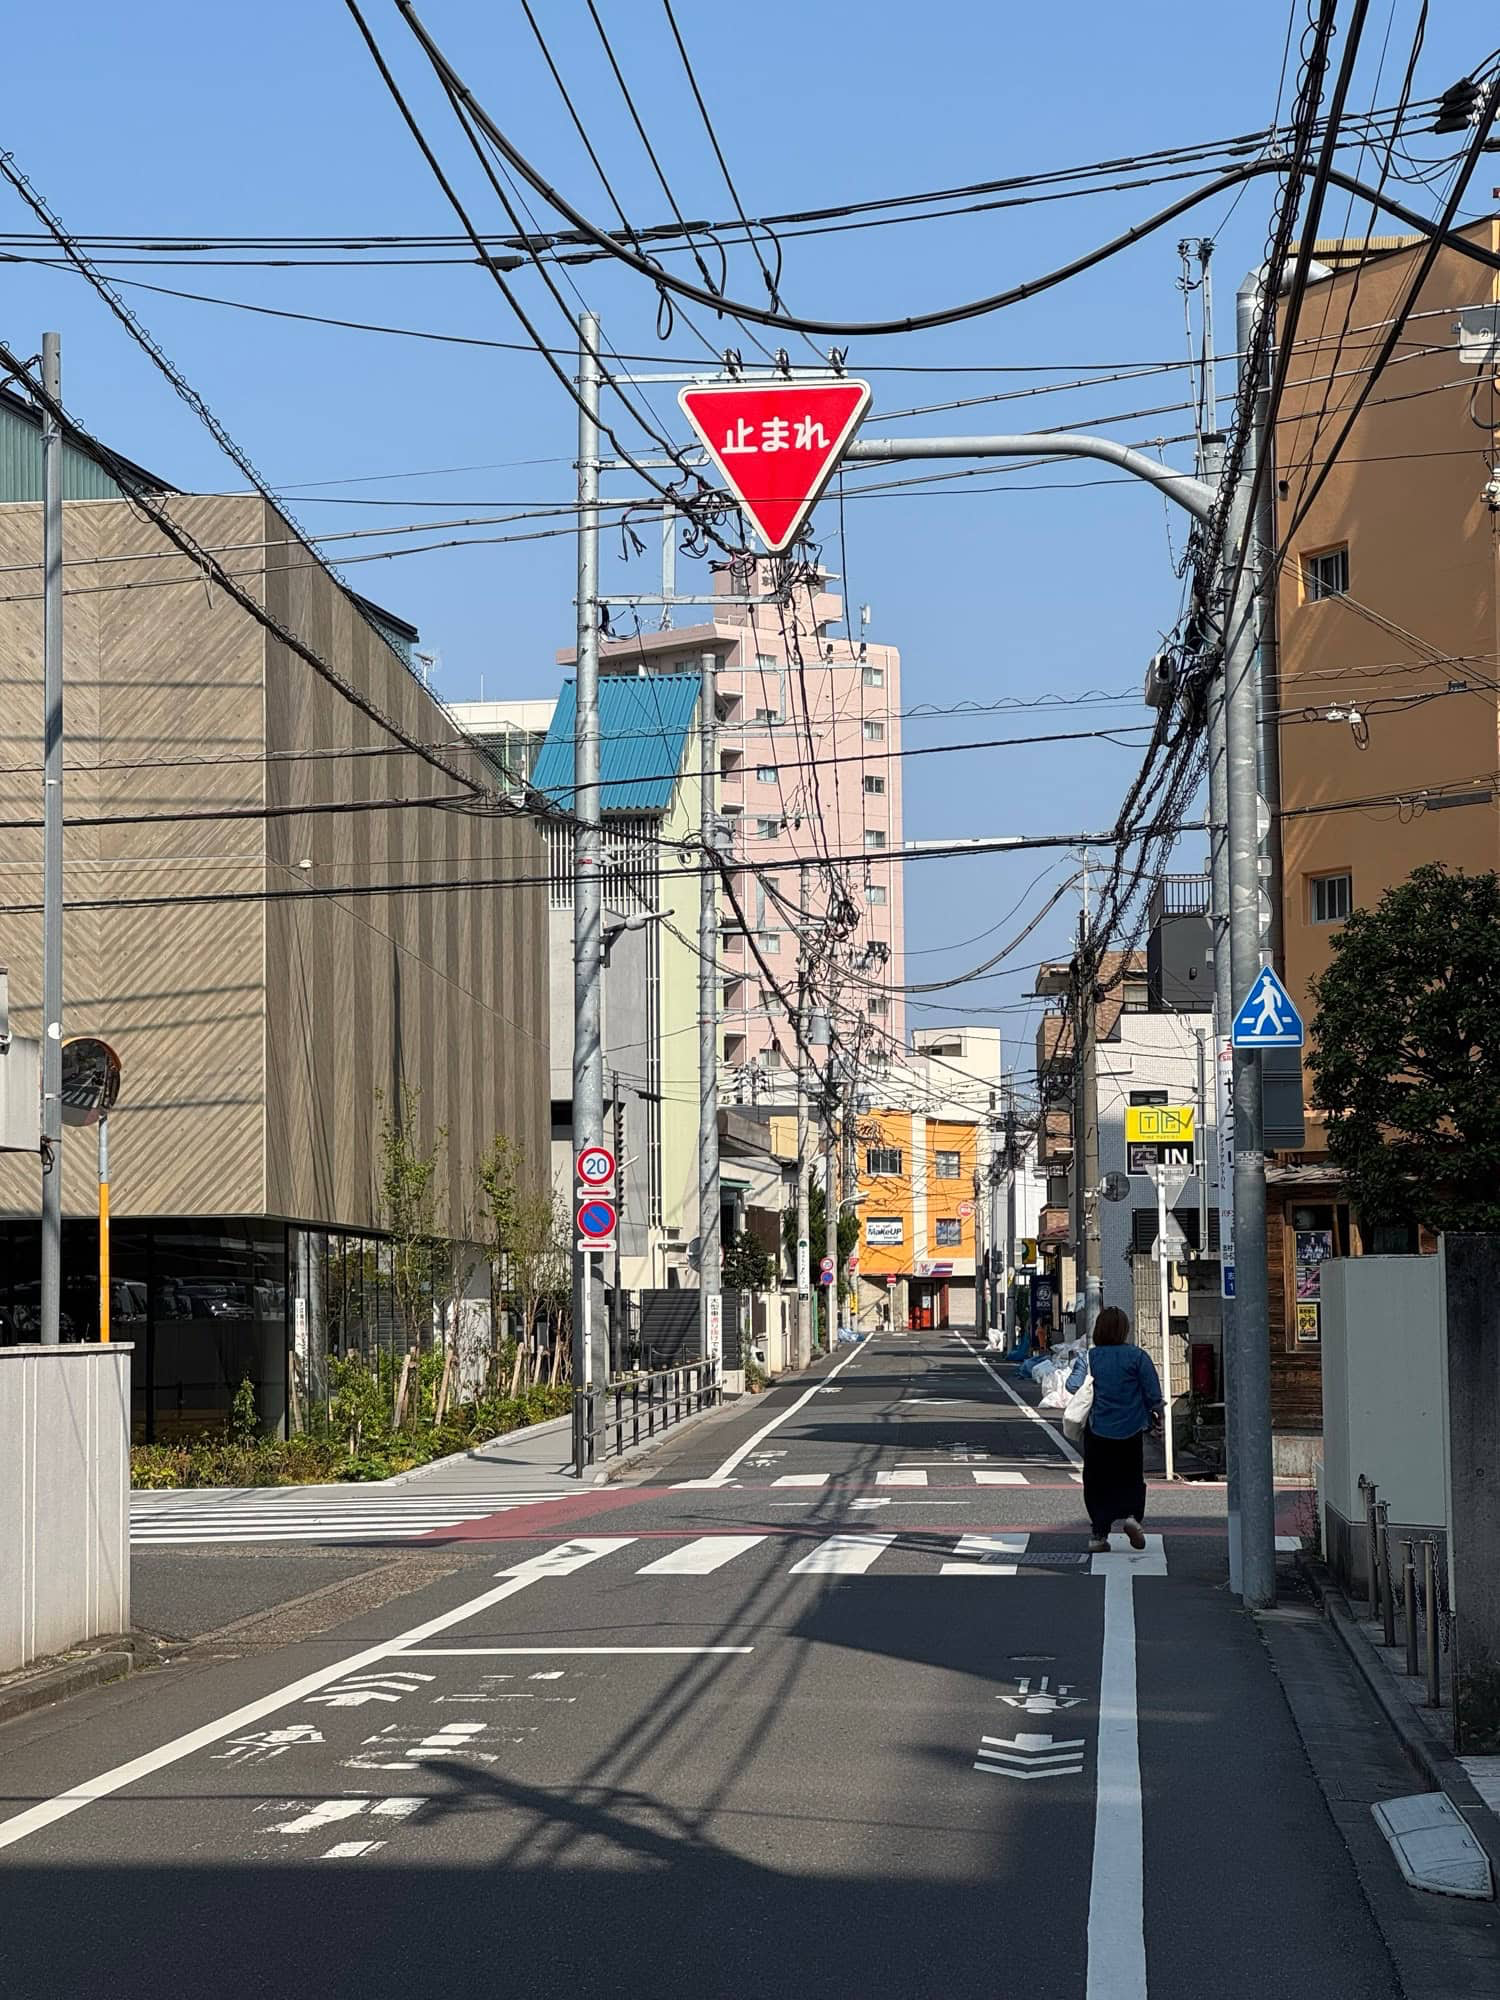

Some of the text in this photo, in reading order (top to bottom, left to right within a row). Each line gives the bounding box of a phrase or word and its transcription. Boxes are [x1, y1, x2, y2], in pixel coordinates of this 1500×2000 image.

[721, 415, 831, 454] 止まれ
[1164, 1148, 1188, 1165] IN
[586, 1158, 607, 1175] 20
